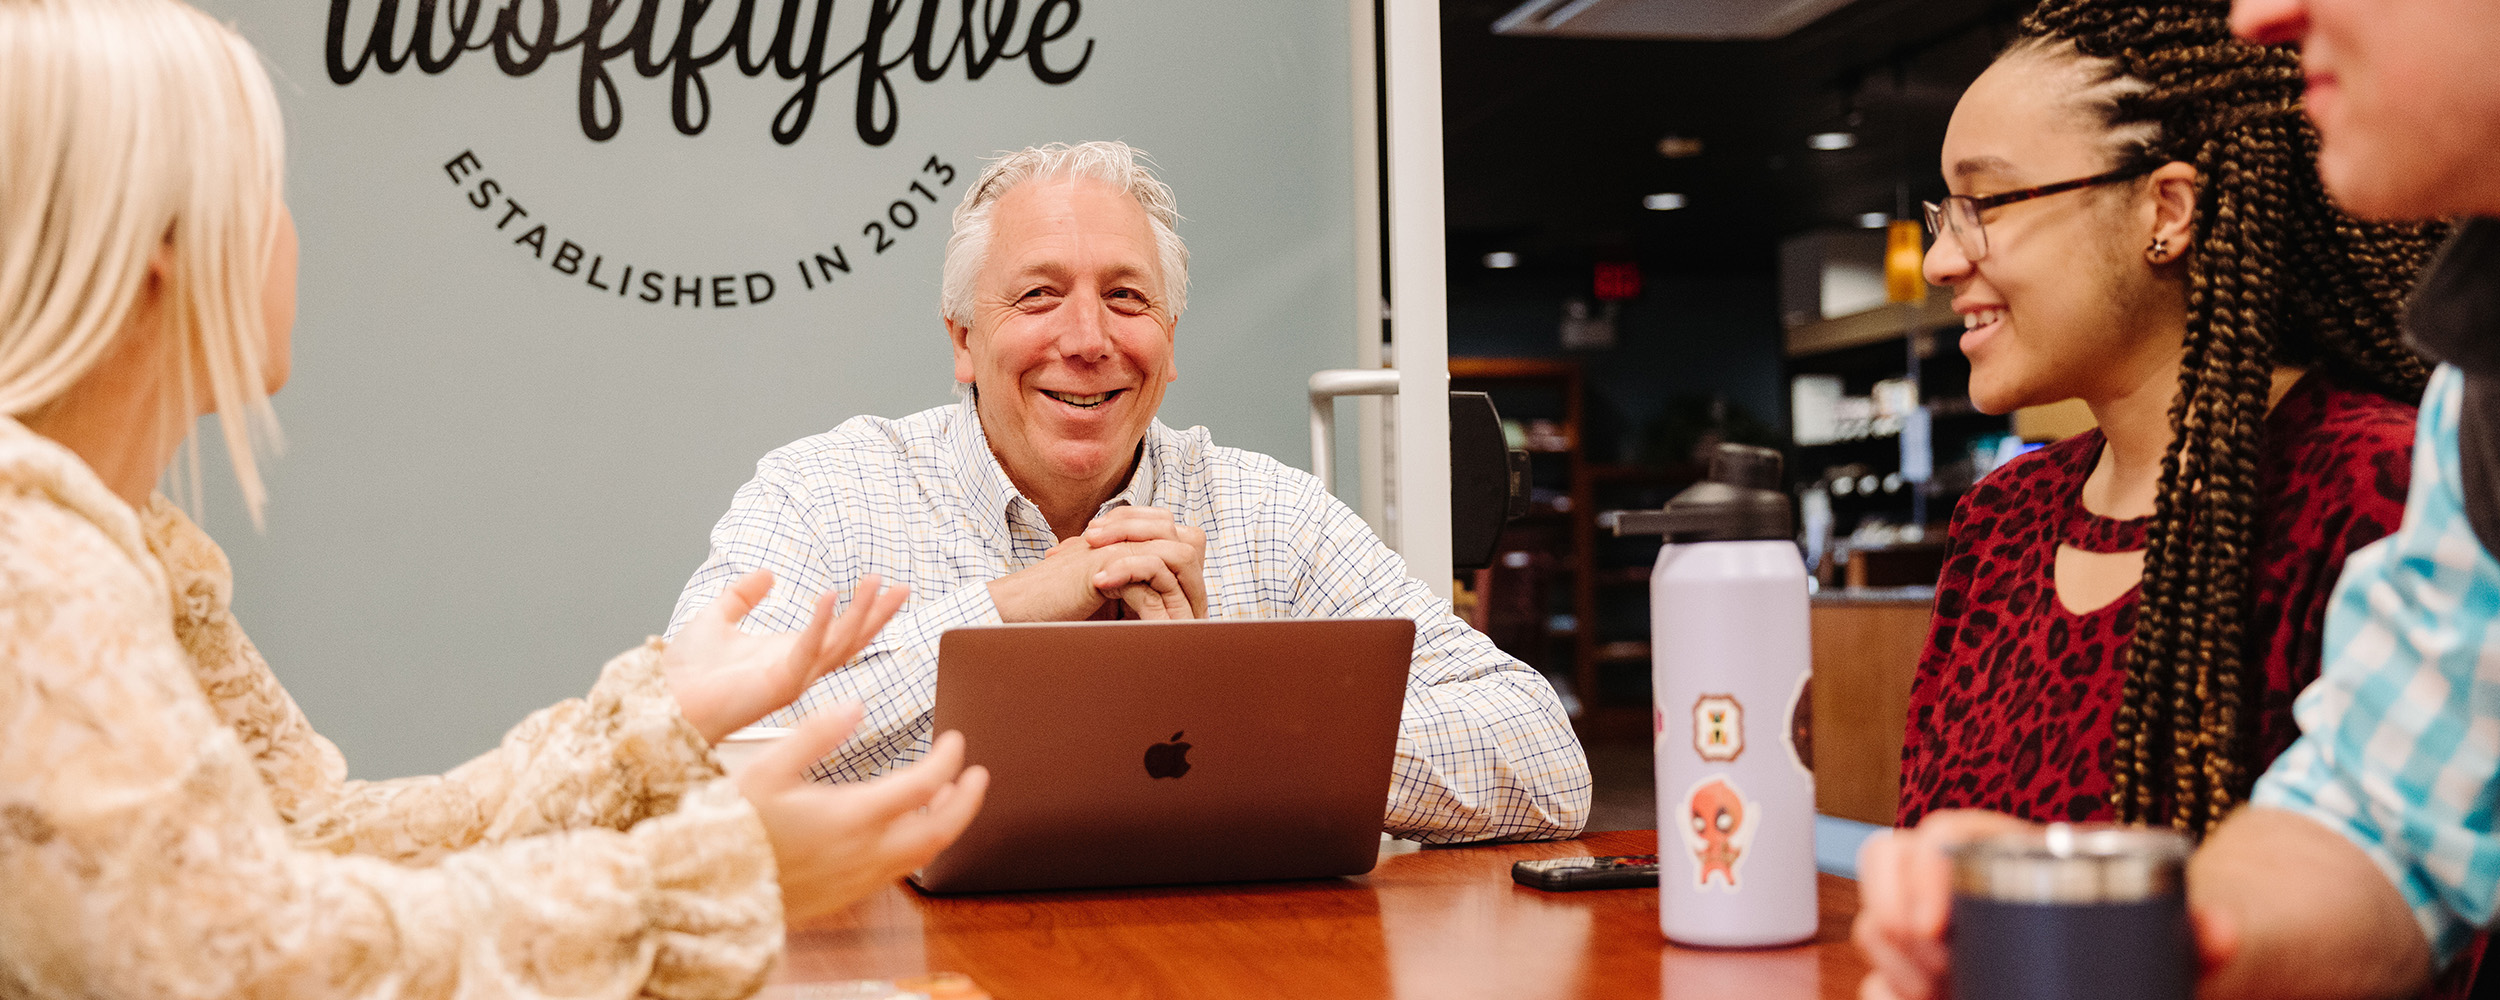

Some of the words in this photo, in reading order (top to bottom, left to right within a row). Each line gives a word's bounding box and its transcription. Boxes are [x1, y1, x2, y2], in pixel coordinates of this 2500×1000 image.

[443, 150, 776, 309] ESTABLISHED
[797, 245, 851, 291] IN
[863, 154, 956, 255] 2013
